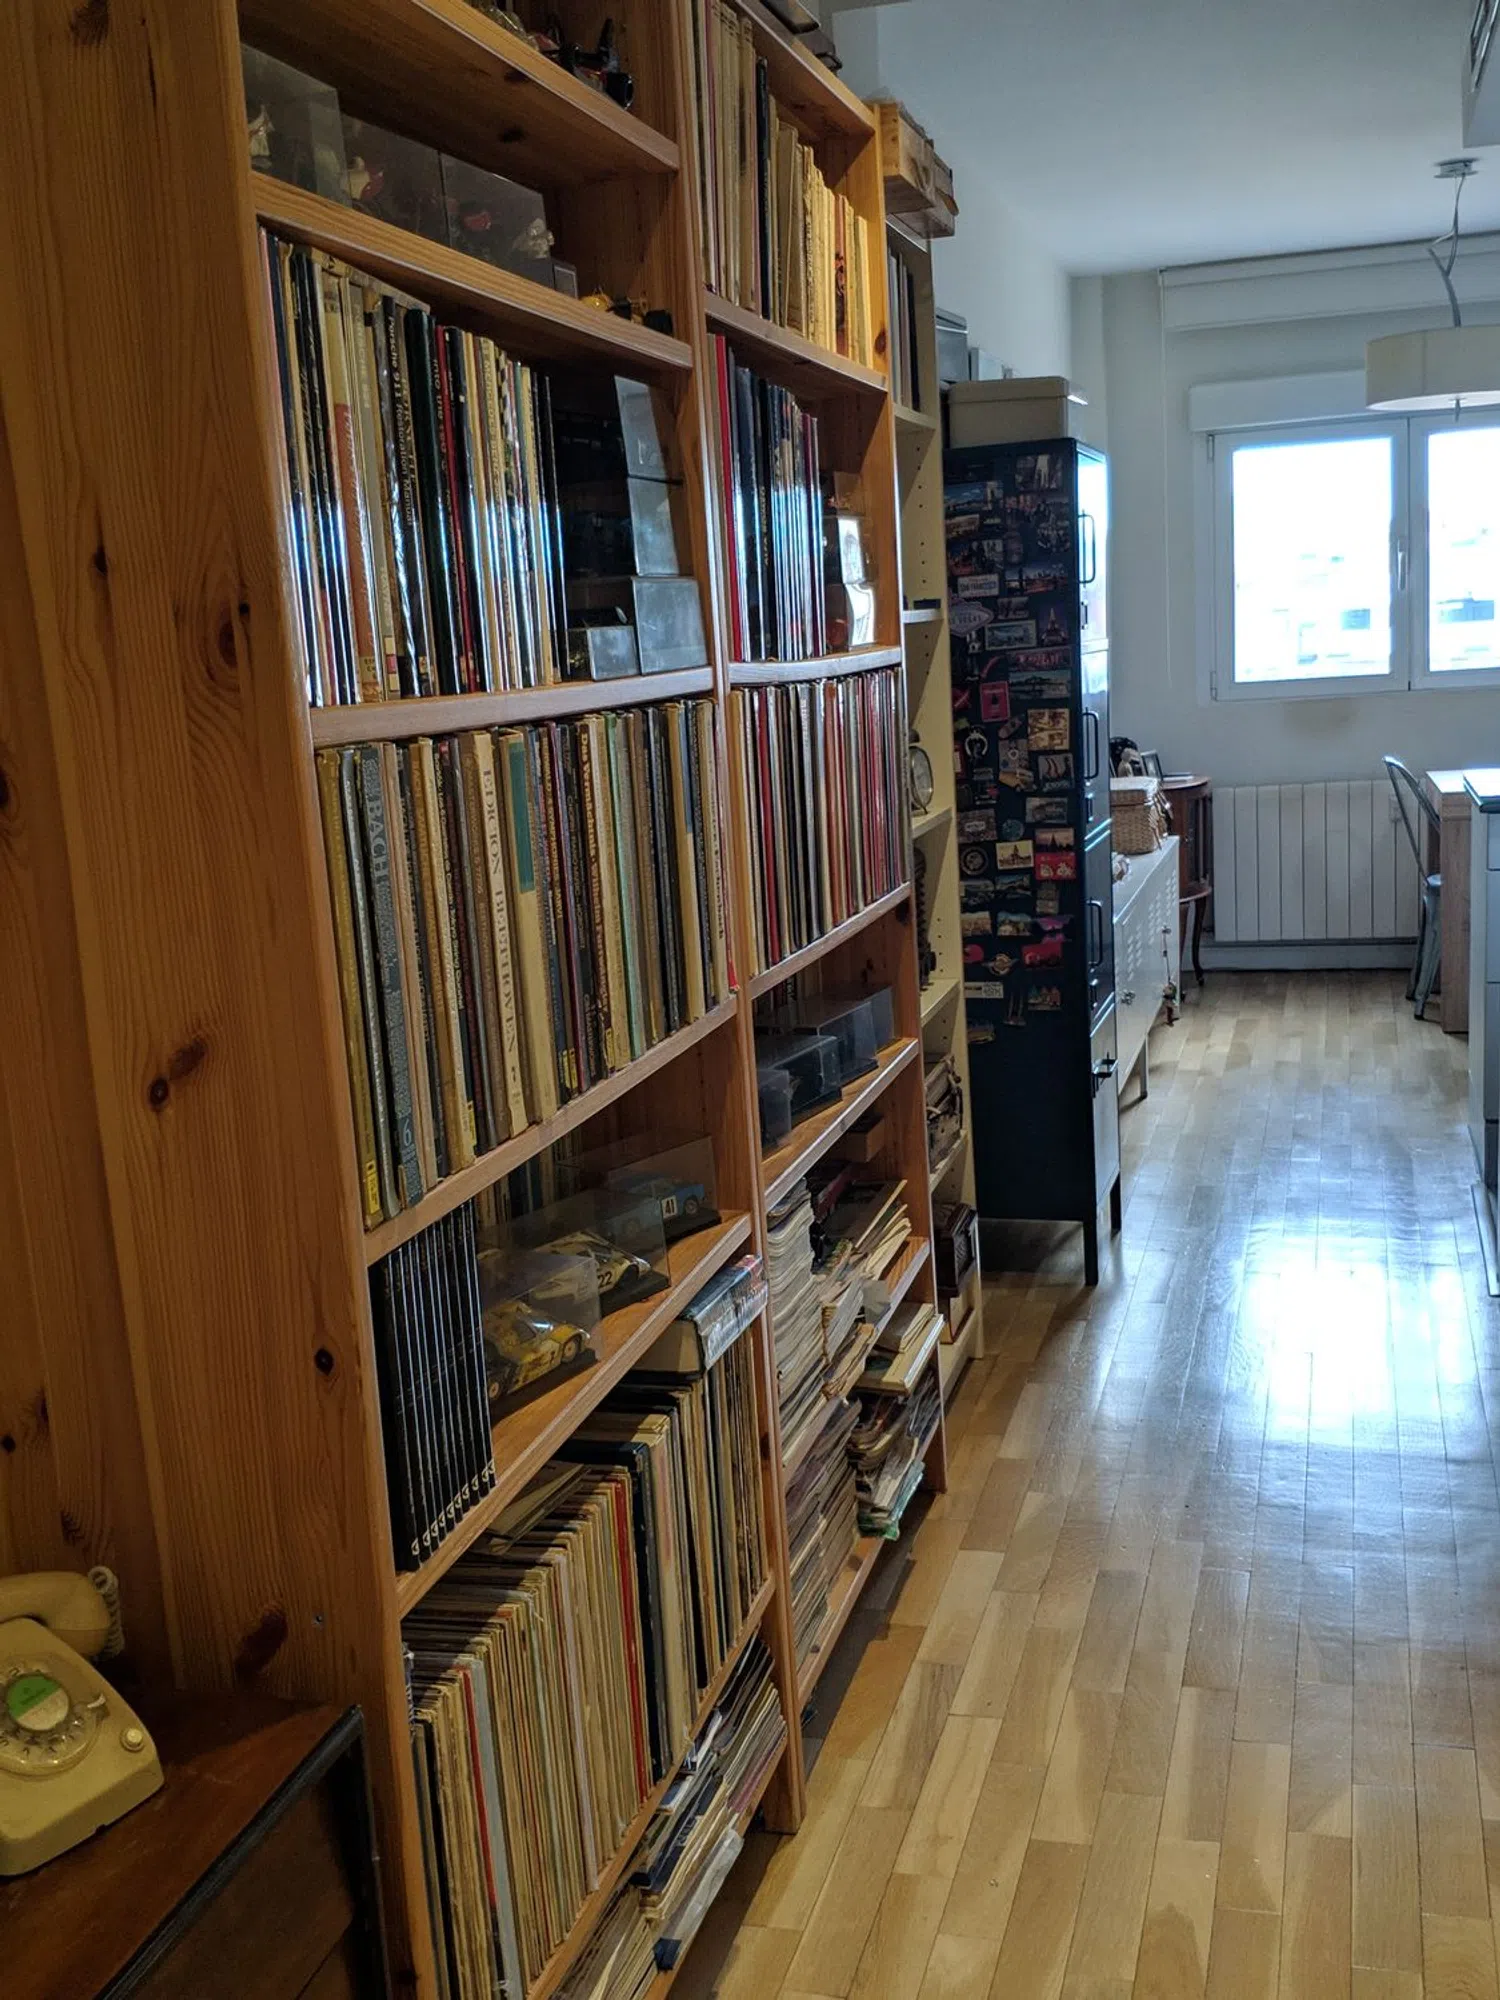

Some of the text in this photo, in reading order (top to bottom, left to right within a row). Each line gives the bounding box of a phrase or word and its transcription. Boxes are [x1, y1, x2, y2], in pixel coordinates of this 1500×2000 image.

[387, 315, 413, 526] Porsche 911 Restoration Manual
[580, 733, 588, 761] Das
[367, 800, 387, 877] BACH
[581, 762, 596, 856] Vermächtnis
[482, 769, 516, 1053] EDICION BEETHOVEN
[589, 864, 602, 924] Wilhelm
[665, 1199, 675, 1214] 41
[597, 1271, 612, 1287] 22
